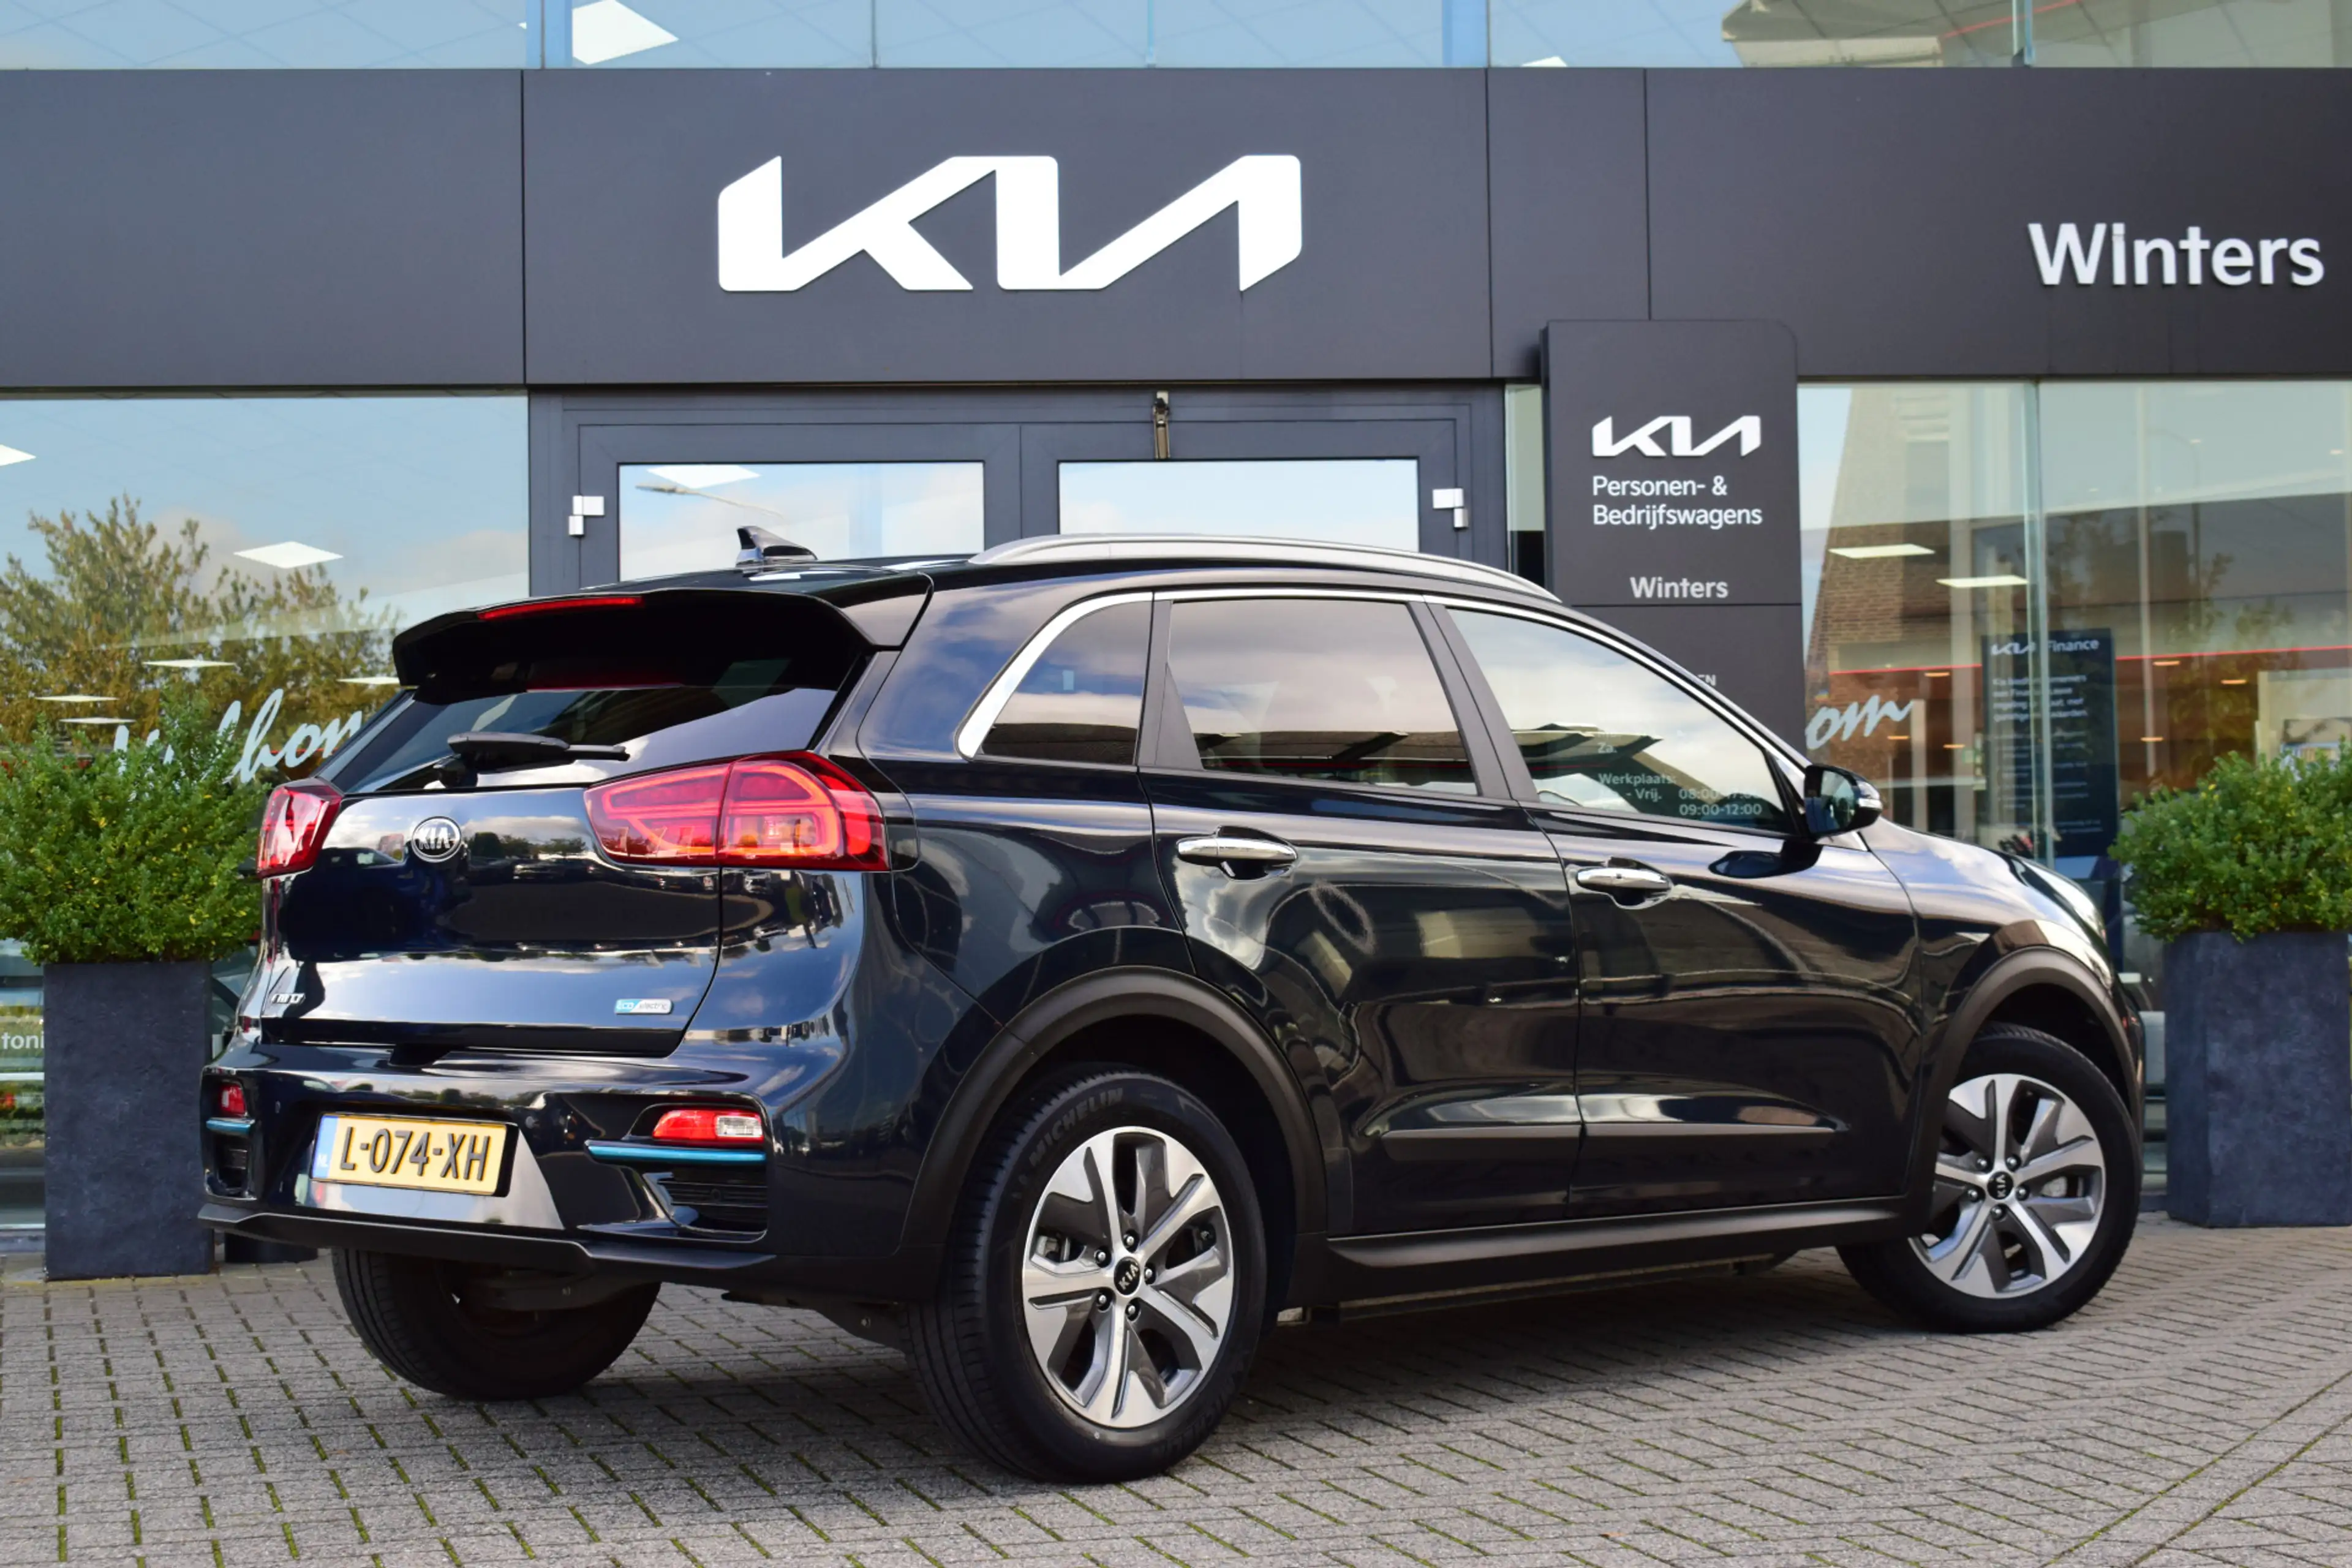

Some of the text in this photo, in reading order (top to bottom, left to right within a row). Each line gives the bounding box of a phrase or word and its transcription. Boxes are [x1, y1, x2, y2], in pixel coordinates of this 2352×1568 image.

[718, 154, 1303, 292] KIA
[2027, 222, 2325, 286] Winters
[1592, 415, 1761, 457] KIA
[1593, 475, 1728, 496] Personen- &
[1593, 503, 1763, 530] Bedrijfswagens
[1630, 576, 1729, 599] Winters
[1679, 804, 1763, 816] 09:00-12:00
[418, 826, 451, 850] KIA
[1028, 1088, 1123, 1167] MICHELIN
[340, 1126, 491, 1182] L-074-XH
[1118, 1264, 1139, 1291] KIA
